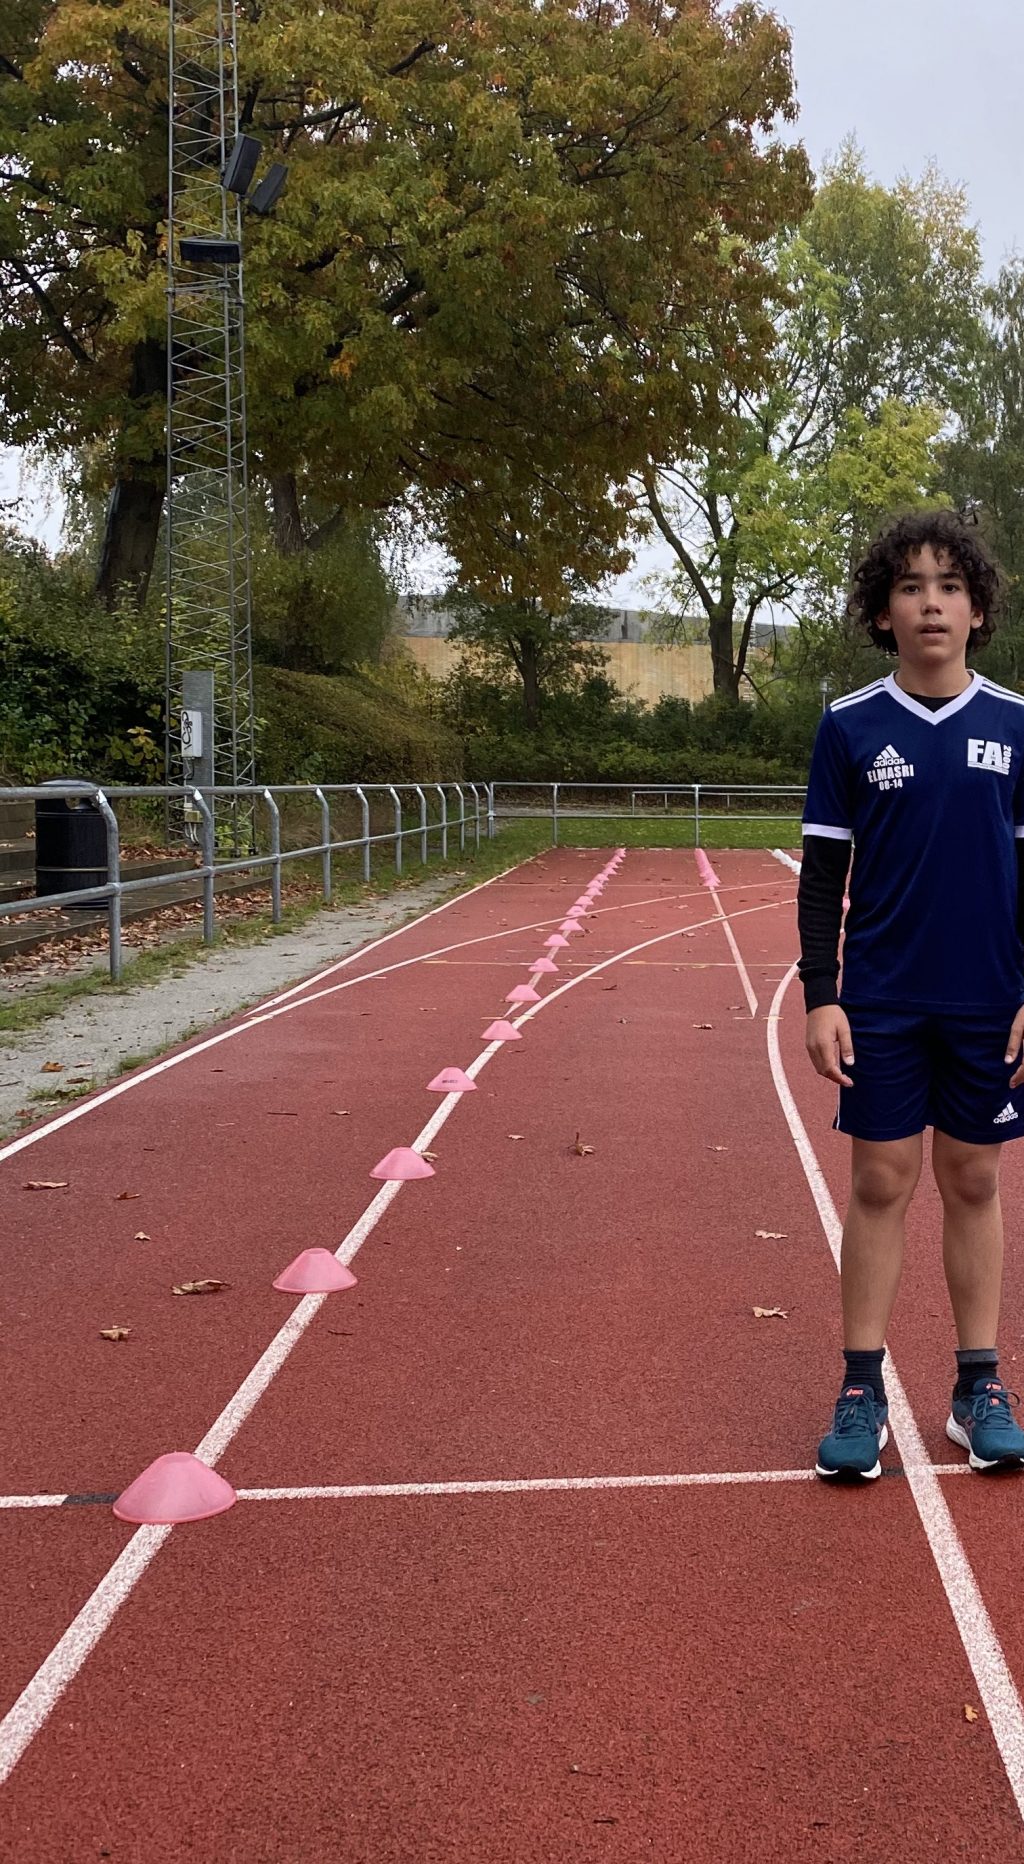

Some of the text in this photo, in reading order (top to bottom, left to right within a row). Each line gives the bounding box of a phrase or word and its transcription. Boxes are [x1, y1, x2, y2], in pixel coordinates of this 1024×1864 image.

[873, 757, 906, 768] adidas
[968, 738, 1003, 767] FA
[1002, 744, 1012, 769] 2000
[866, 764, 915, 784] ELMASRI
